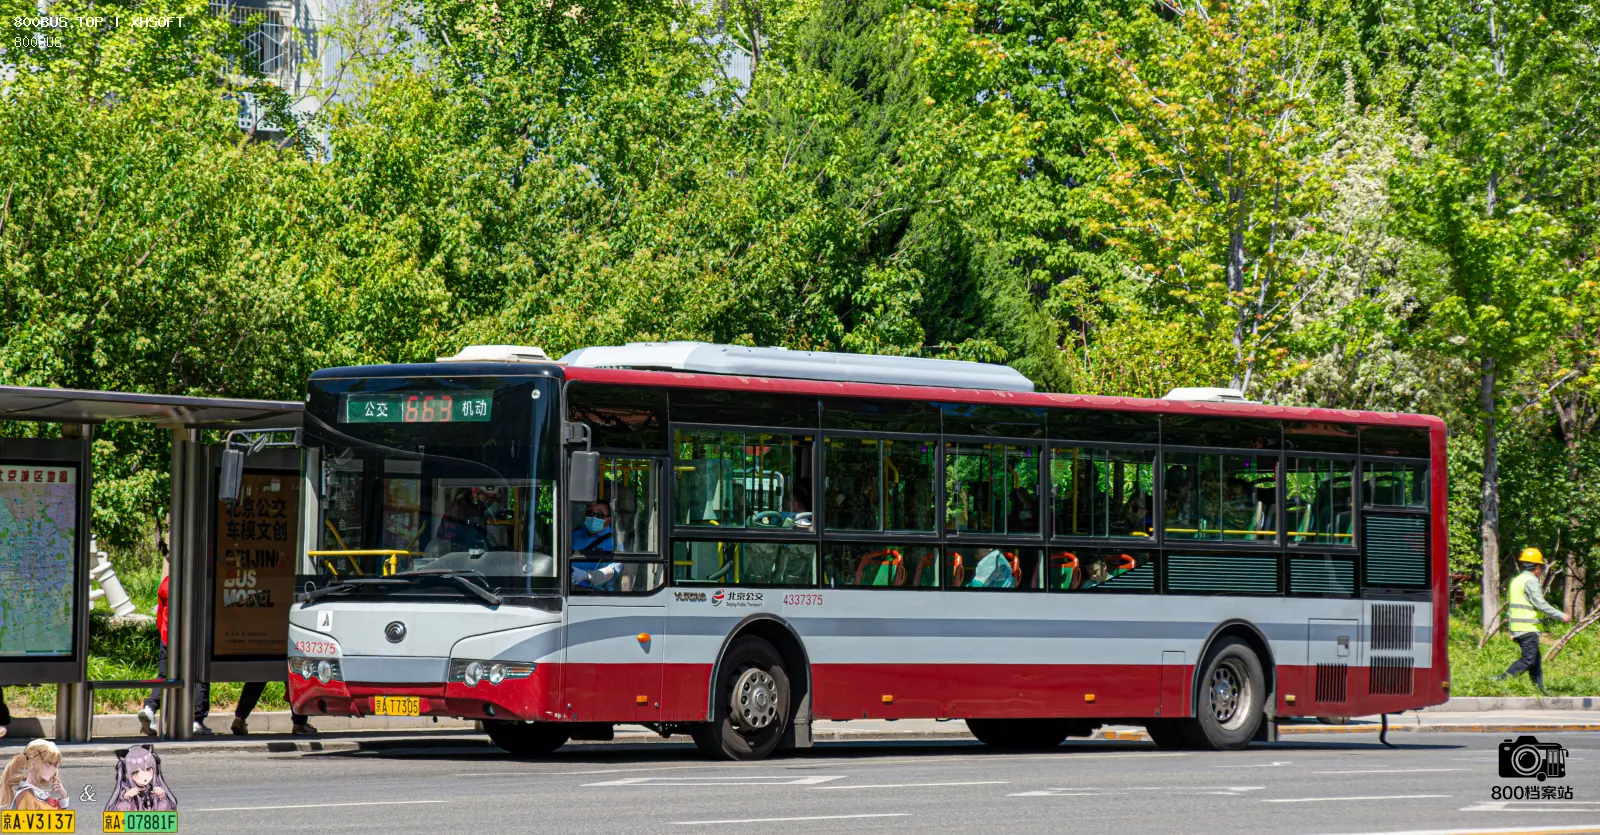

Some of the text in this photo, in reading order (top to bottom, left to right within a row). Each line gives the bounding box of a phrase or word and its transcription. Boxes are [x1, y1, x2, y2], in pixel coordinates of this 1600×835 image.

[364, 395, 487, 423] 公交 663 机动
[226, 519, 288, 541] 车模文创
[224, 569, 257, 588] BUS
[727, 591, 764, 601] 北京公交
[783, 594, 823, 606] 4337375
[295, 641, 337, 655] 4337375
